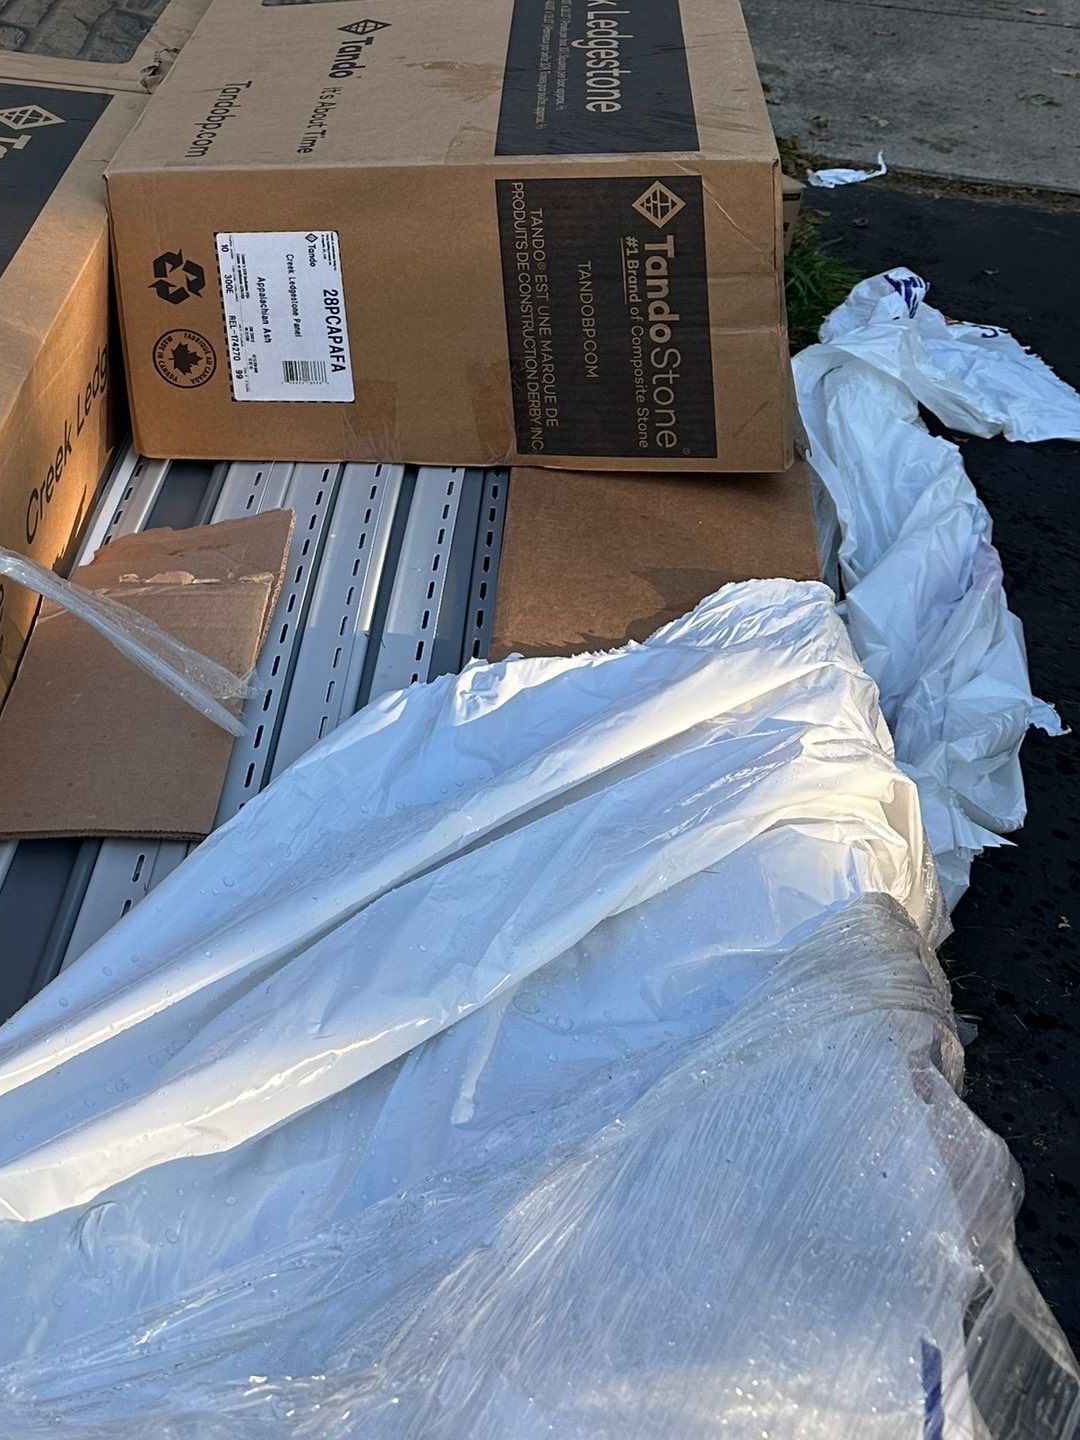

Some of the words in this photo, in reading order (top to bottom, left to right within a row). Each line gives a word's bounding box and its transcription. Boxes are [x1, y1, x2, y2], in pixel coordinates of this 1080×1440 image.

[328, 37, 374, 79] Tando
[571, 11, 634, 112] Ledgestone
[319, 87, 343, 100] It's
[185, 80, 253, 158] Tandobp.com
[308, 101, 336, 128] About
[297, 129, 327, 154] Time
[511, 182, 528, 250] PRODUITS
[221, 244, 229, 252] 10
[308, 244, 316, 267] Tando
[625, 236, 638, 256] #1
[286, 254, 295, 274] Creek
[516, 252, 530, 270] DE
[224, 274, 234, 294] 300E
[535, 274, 549, 301] EST
[627, 259, 643, 303] Brand
[257, 277, 270, 325] Appalachian
[288, 277, 299, 317] Ledgestone
[517, 272, 537, 377] CONSTRUCTION
[536, 306, 551, 336] UNE
[578, 260, 600, 379] TANDOBP.COM
[630, 306, 644, 322] of
[228, 315, 241, 361] REL-174270
[263, 328, 272, 343] Ash
[293, 318, 303, 338] Panel
[323, 289, 346, 373] 28PCAPAFA
[159, 336, 173, 352] MADE
[184, 333, 211, 355] FABRIQUE
[644, 235, 681, 449] TandoStone
[158, 361, 178, 383] CANADA
[190, 367, 211, 384] CANADA
[235, 369, 243, 379] 99
[538, 339, 557, 404] MARQUE
[630, 325, 645, 403] Composite
[526, 381, 542, 426] DERBY
[545, 408, 559, 427] DE
[637, 408, 649, 449] Stone
[26, 419, 73, 545] Creek
